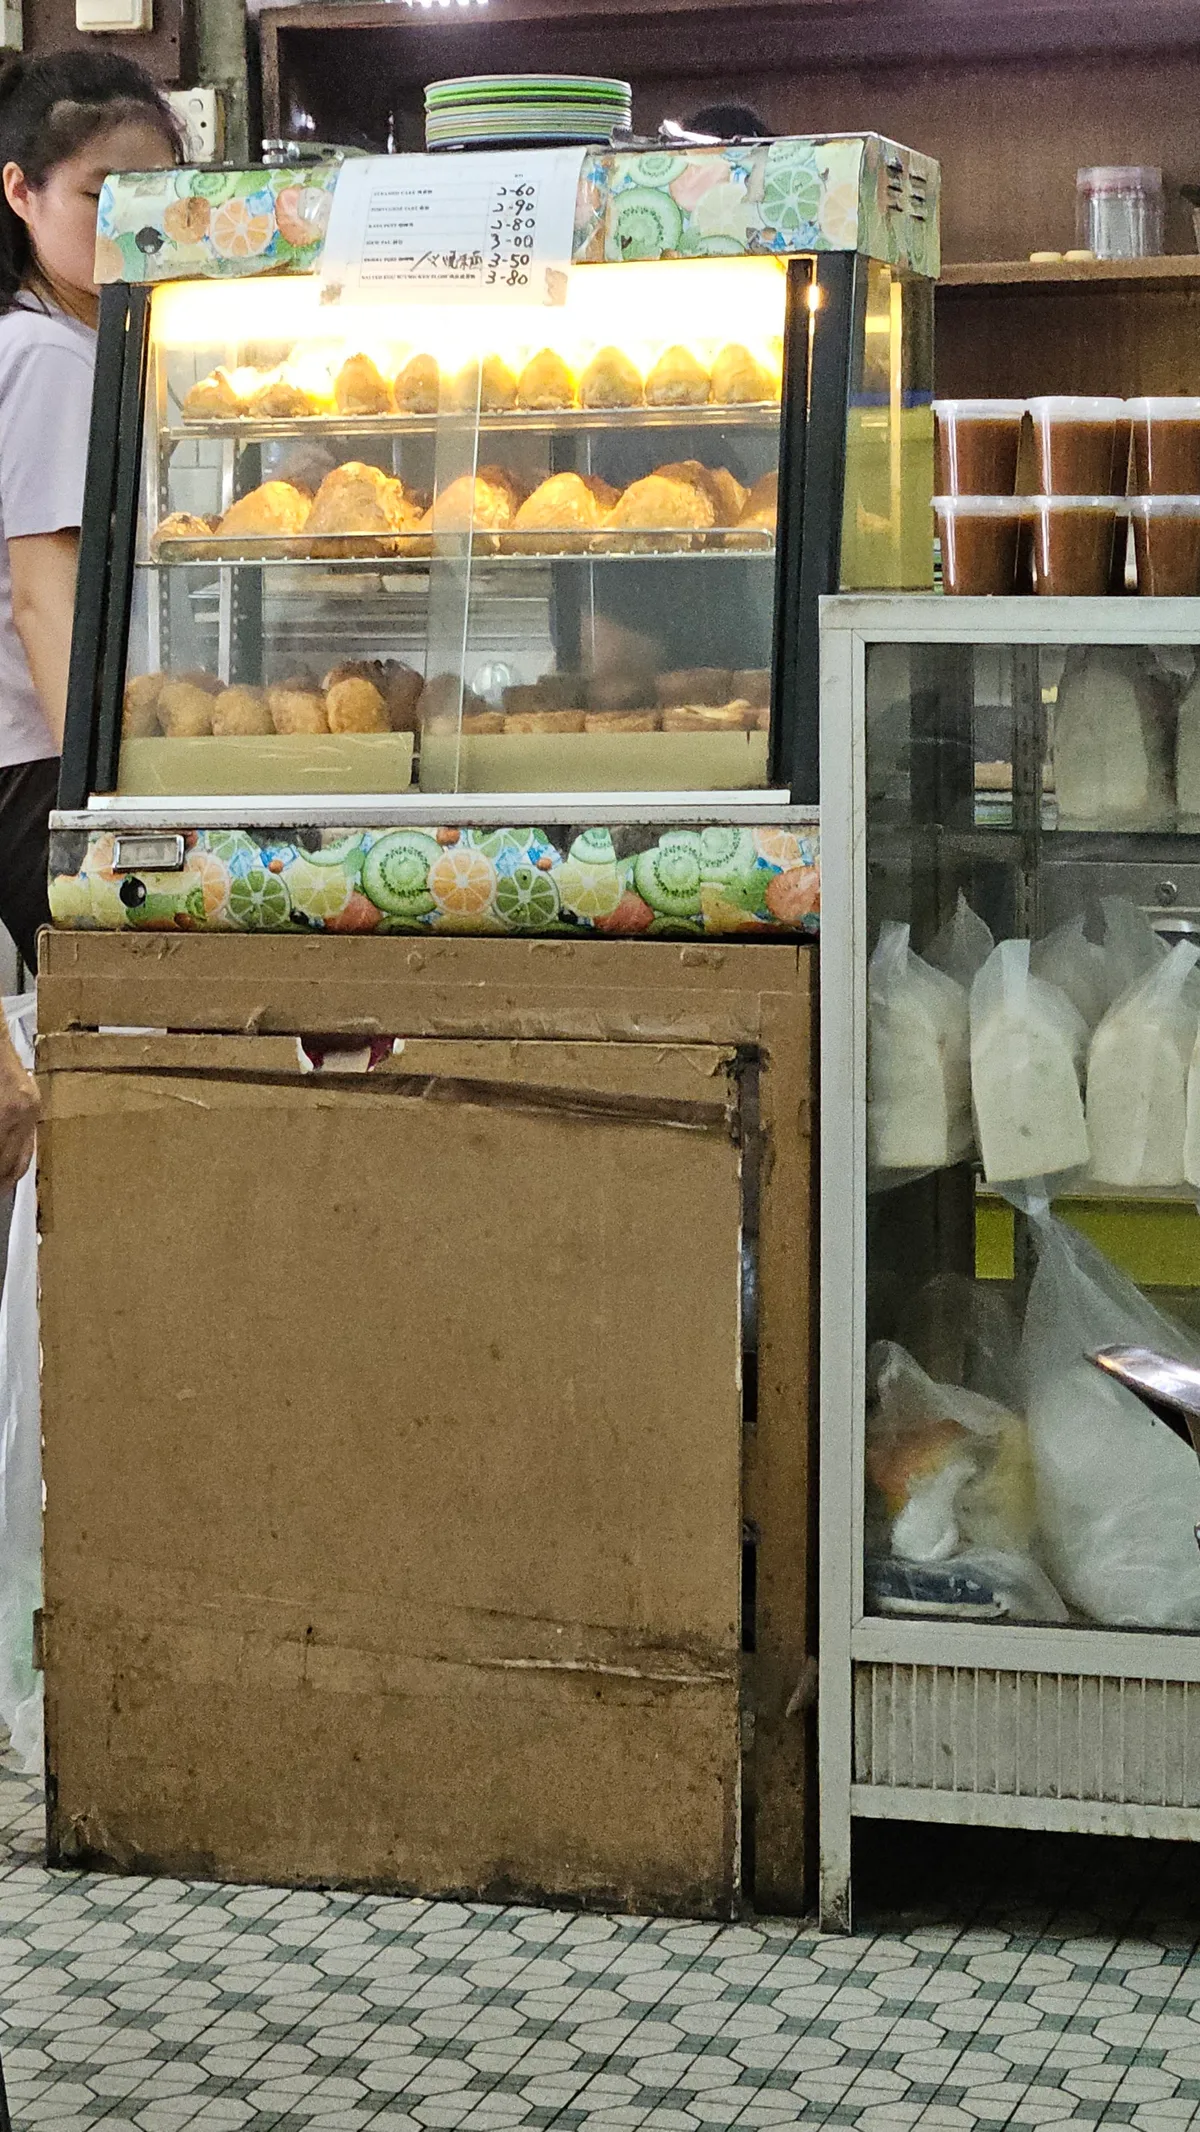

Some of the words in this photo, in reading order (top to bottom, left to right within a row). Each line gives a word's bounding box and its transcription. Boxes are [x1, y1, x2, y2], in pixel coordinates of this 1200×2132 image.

[496, 183, 535, 197] 2-60
[492, 199, 534, 216] 2-90
[490, 218, 535, 231] 2-80
[490, 233, 534, 250] 3-00
[488, 253, 530, 268] 3-50
[485, 269, 528, 286] 3-80
